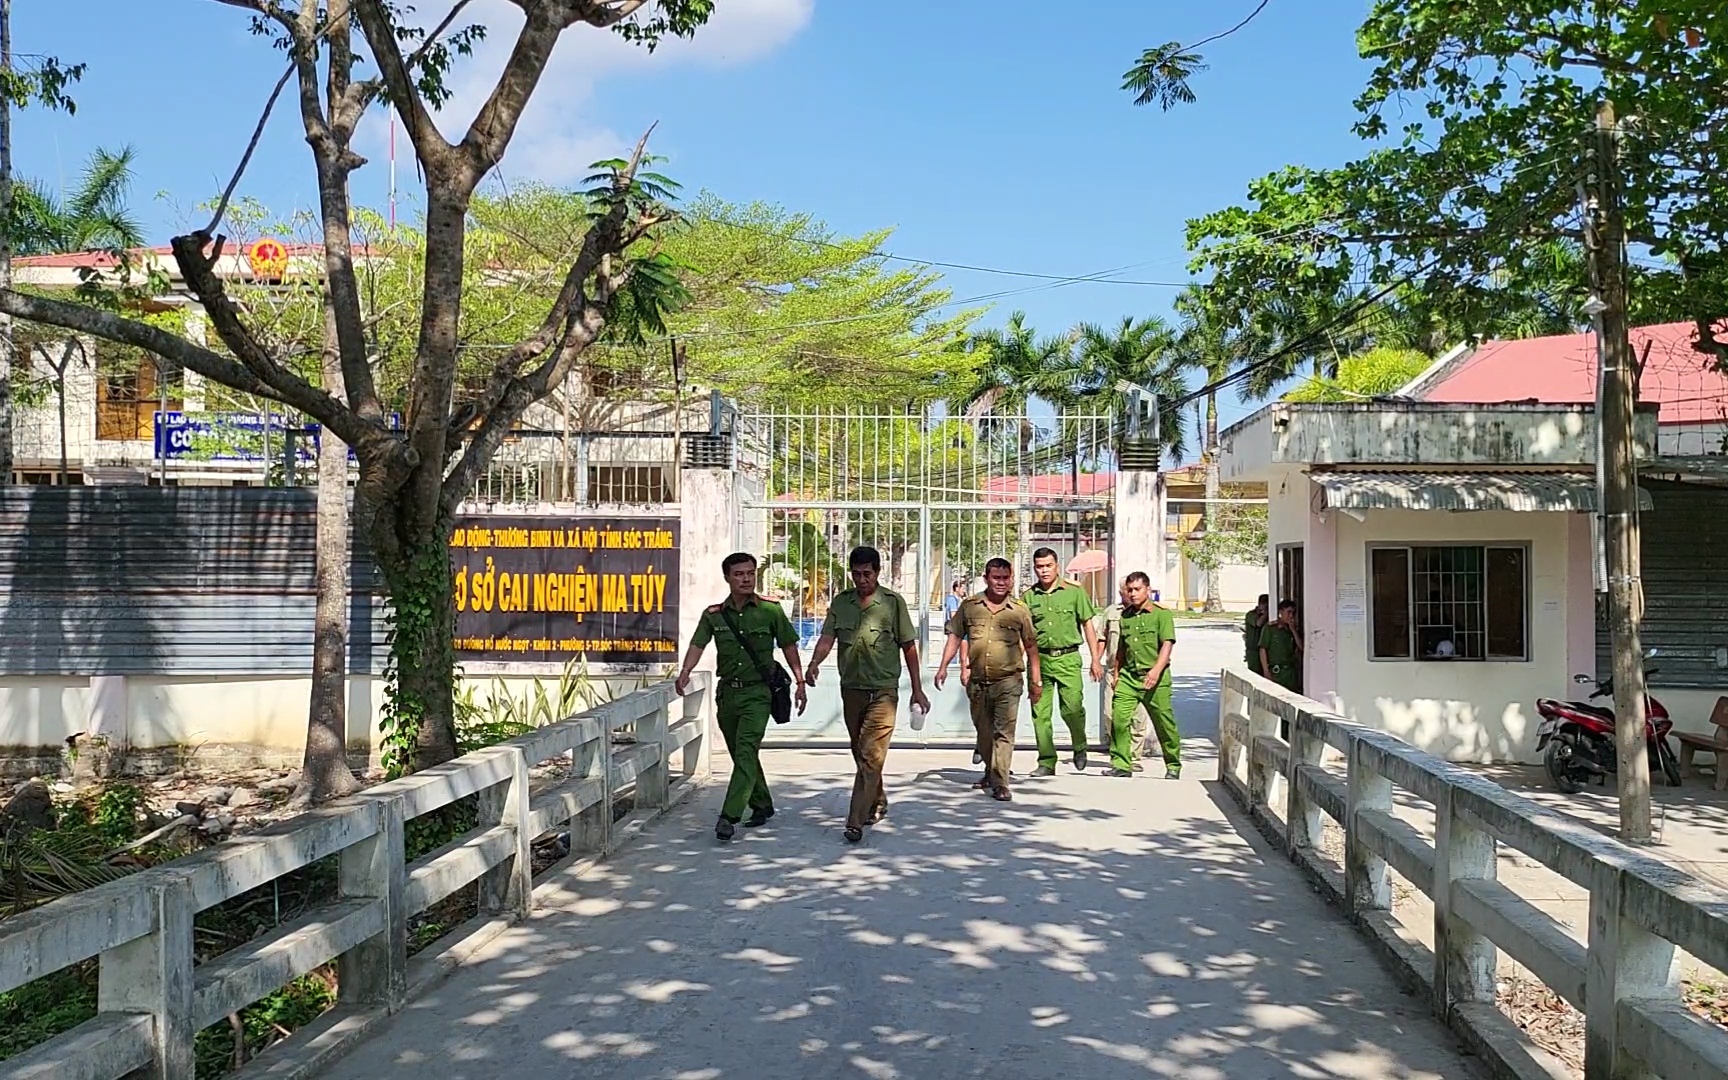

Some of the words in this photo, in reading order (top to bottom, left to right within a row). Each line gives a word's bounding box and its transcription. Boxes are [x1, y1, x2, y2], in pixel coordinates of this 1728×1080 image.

[530, 530, 551, 548] BINH
[553, 526, 565, 548] VÀ
[567, 526, 580, 548] XÃ
[582, 526, 598, 553] HỘI
[600, 524, 622, 549] TỈNH
[622, 527, 642, 549] SÓC
[643, 527, 673, 549] TRĂNG
[455, 565, 467, 612] Ơ
[471, 556, 495, 612] SỞ
[498, 572, 529, 612] CAI
[533, 565, 598, 623] NGHIỆN
[602, 574, 628, 613] MA
[630, 565, 667, 614] TÚY
